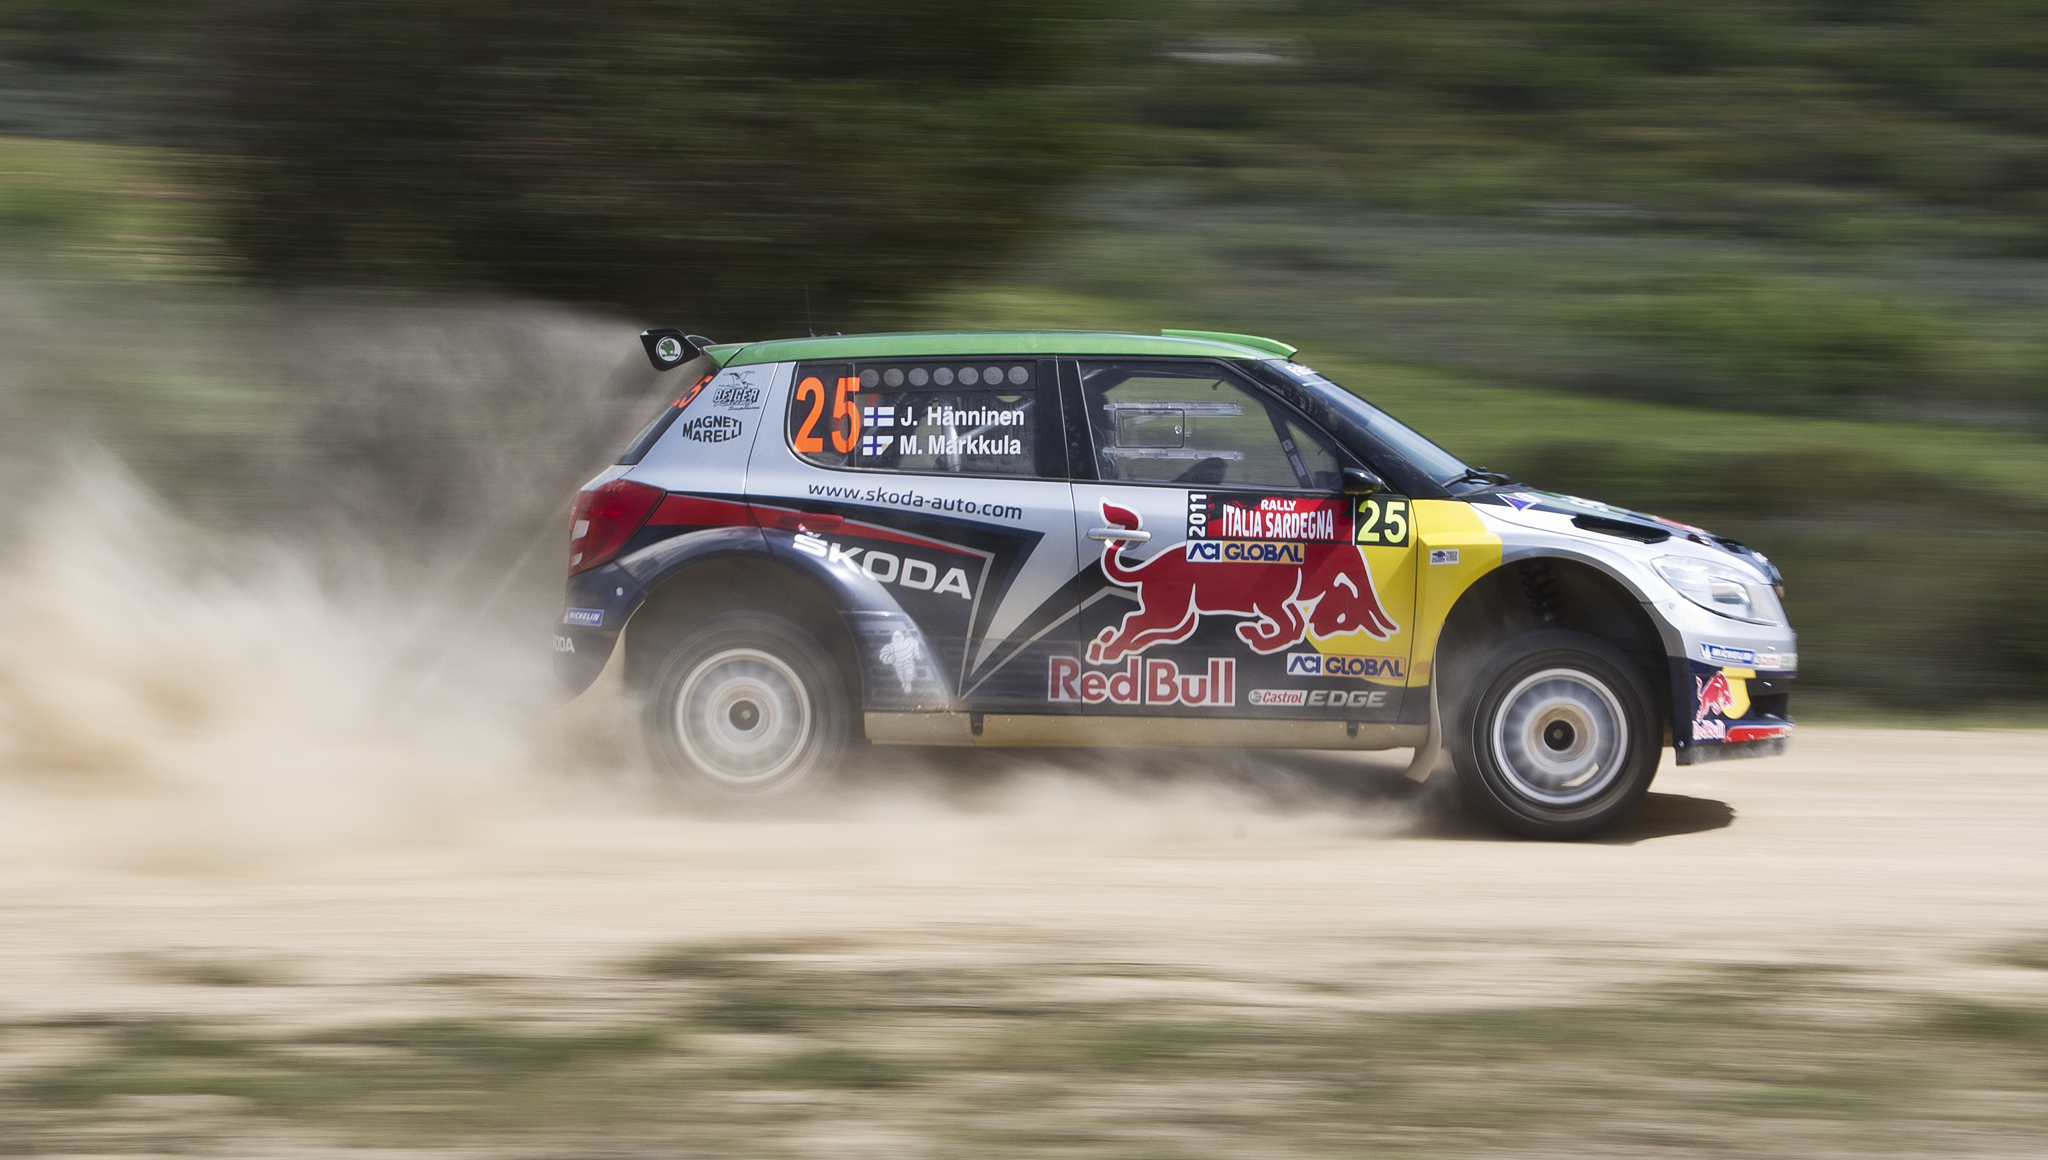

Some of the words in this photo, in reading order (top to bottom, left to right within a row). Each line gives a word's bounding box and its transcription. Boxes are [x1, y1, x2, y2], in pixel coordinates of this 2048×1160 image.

[683, 415, 742, 434] MAGNETI
[793, 377, 861, 454] 25
[901, 406, 918, 426] J.
[927, 406, 1025, 426] Hänninen
[683, 422, 742, 443] MARELLI
[900, 435, 922, 455] M.
[928, 434, 1022, 455] Markkula
[808, 484, 1023, 520] www.skoda-auto.com
[1261, 499, 1297, 511] RALLY
[1189, 493, 1208, 538] 2011
[1222, 504, 1263, 538] ITALIA
[1265, 508, 1334, 539] SARDEGNA
[1357, 500, 1408, 543] 25
[793, 524, 972, 600] ŠKODA
[1188, 542, 1221, 561] ACI
[1224, 543, 1304, 563] GLOBAL
[1288, 655, 1321, 674] ACI
[1325, 656, 1404, 678] GLOBAL
[1049, 656, 1141, 704] Red
[1146, 658, 1236, 706] Bull
[1262, 690, 1304, 704] Castrol
[1306, 689, 1388, 708] EDGE
